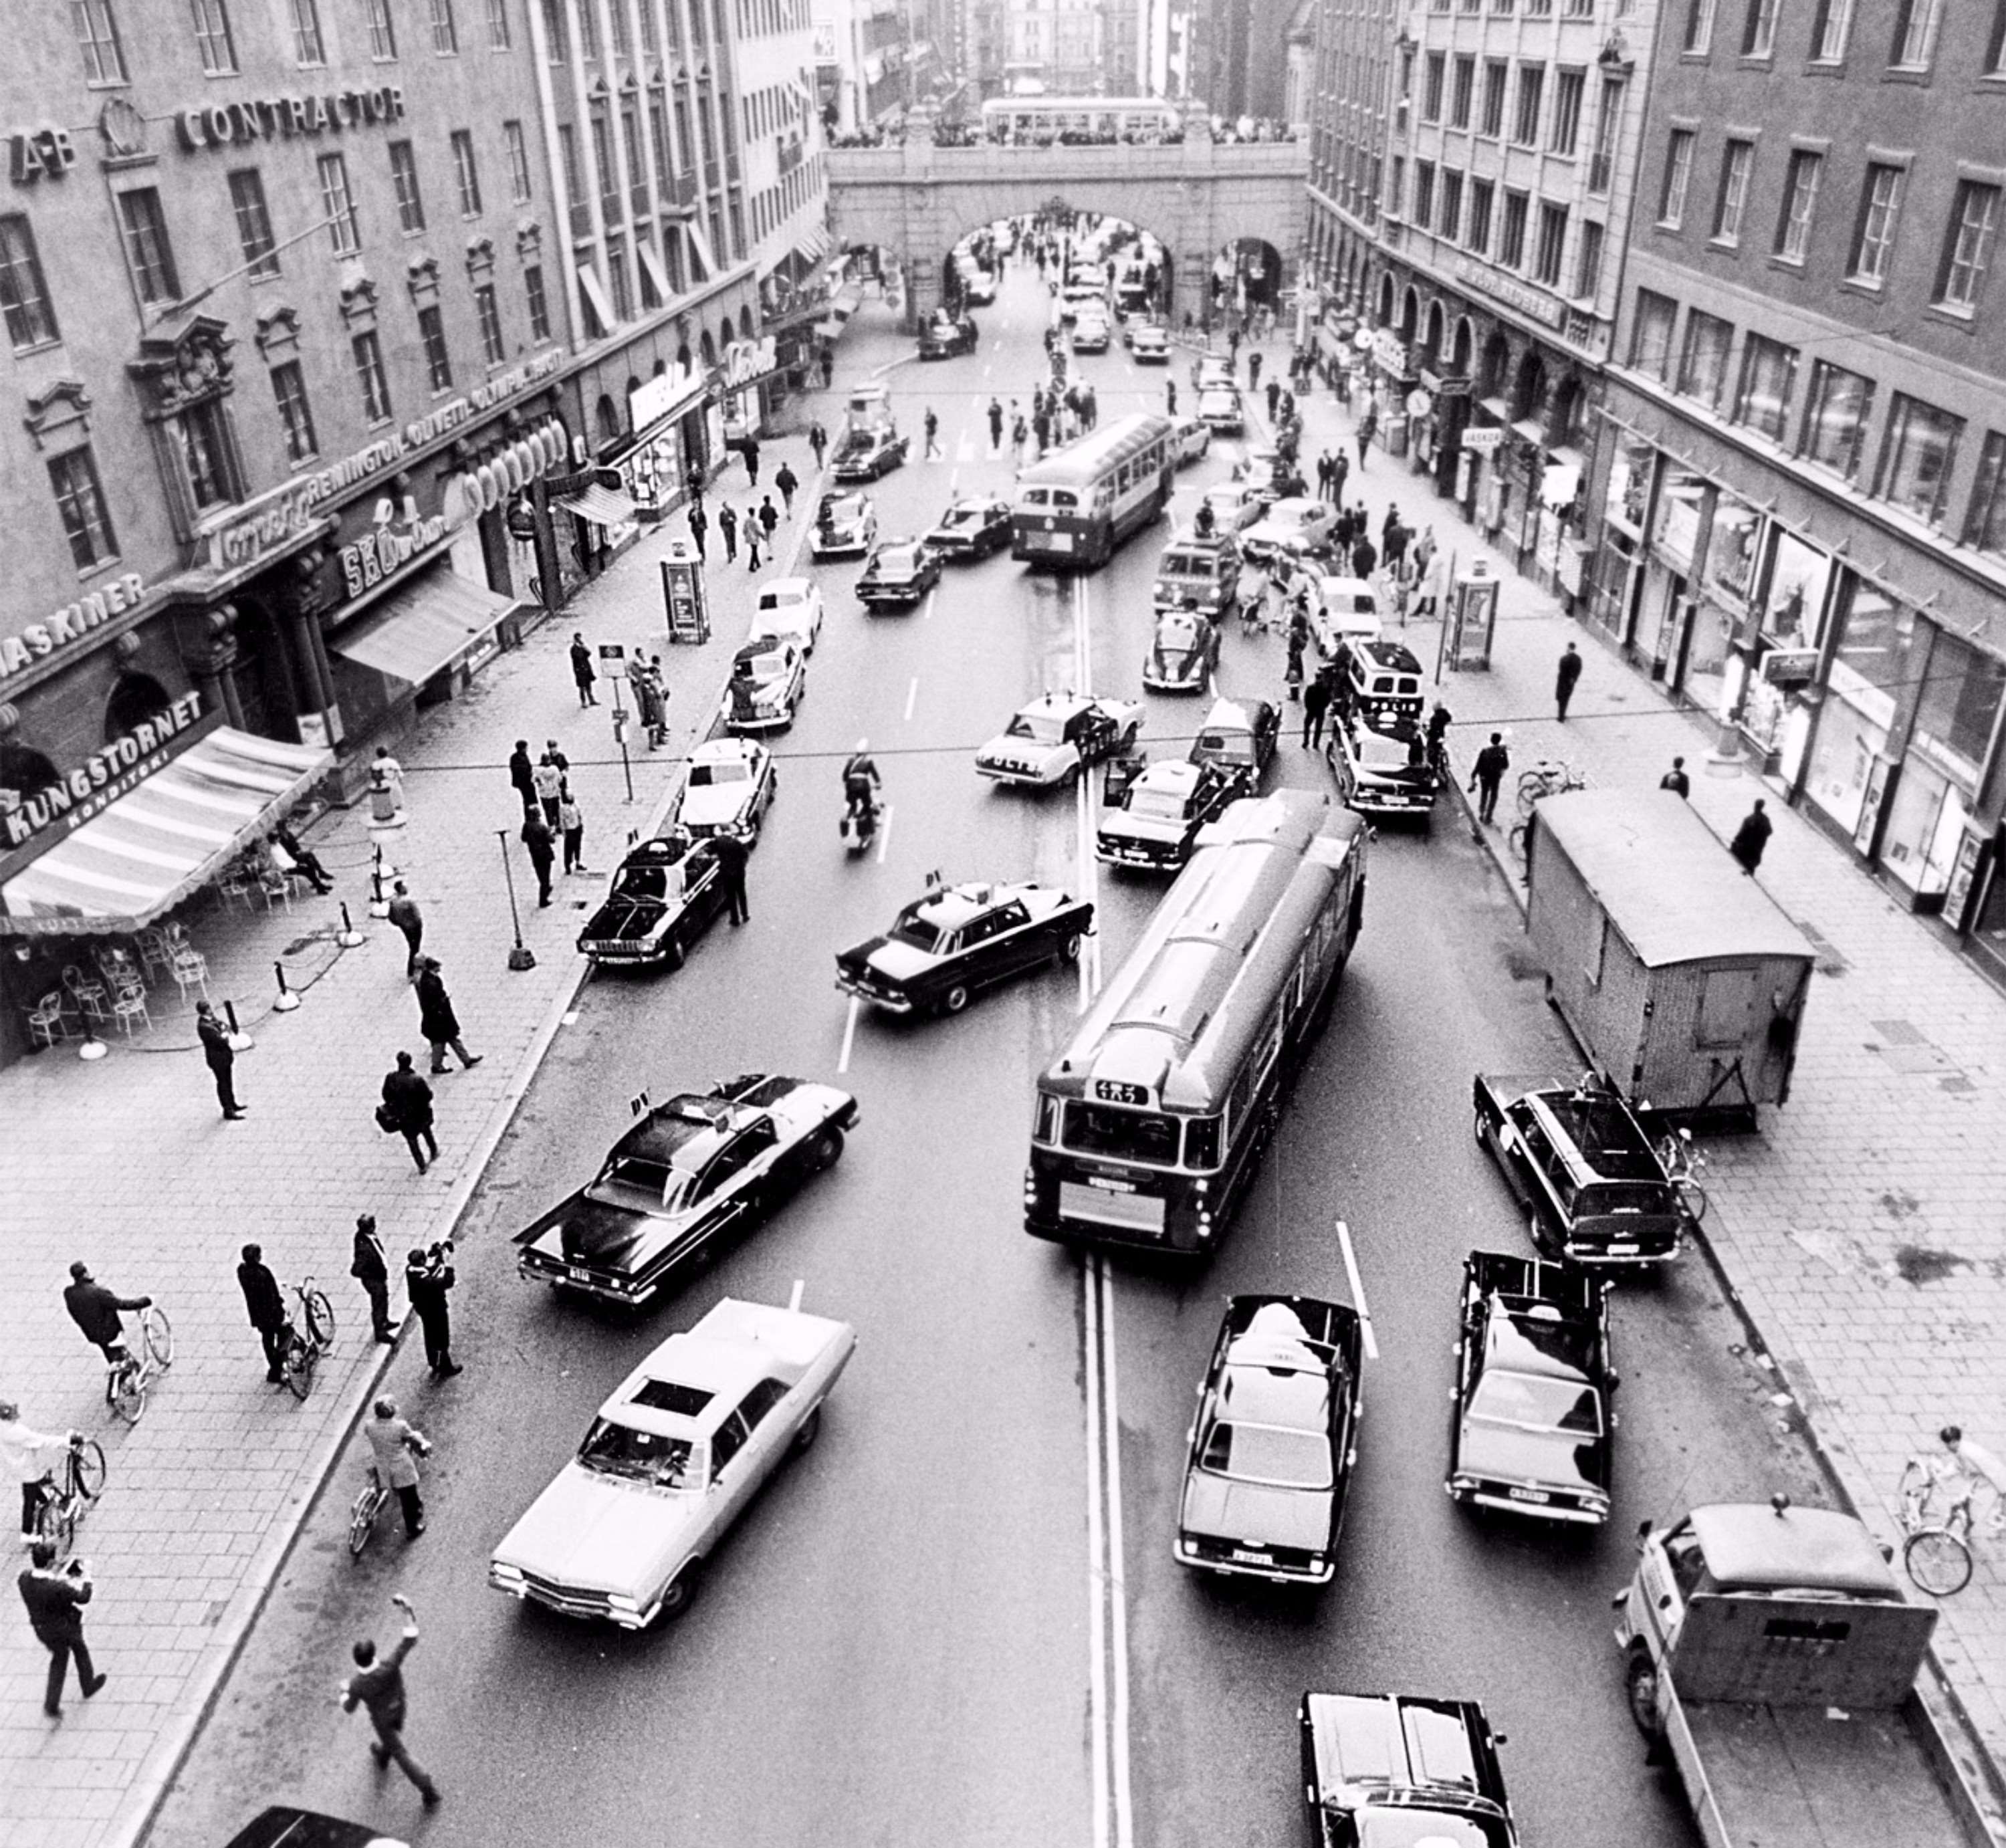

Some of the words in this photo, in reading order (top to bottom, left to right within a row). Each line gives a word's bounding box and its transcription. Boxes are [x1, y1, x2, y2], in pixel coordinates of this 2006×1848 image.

[175, 87, 405, 152] CONTRACTOR
[1371, 701, 1416, 712] POLIS
[6, 691, 200, 844] KUNGSTORNET
[68, 749, 169, 828] KONDITORI
